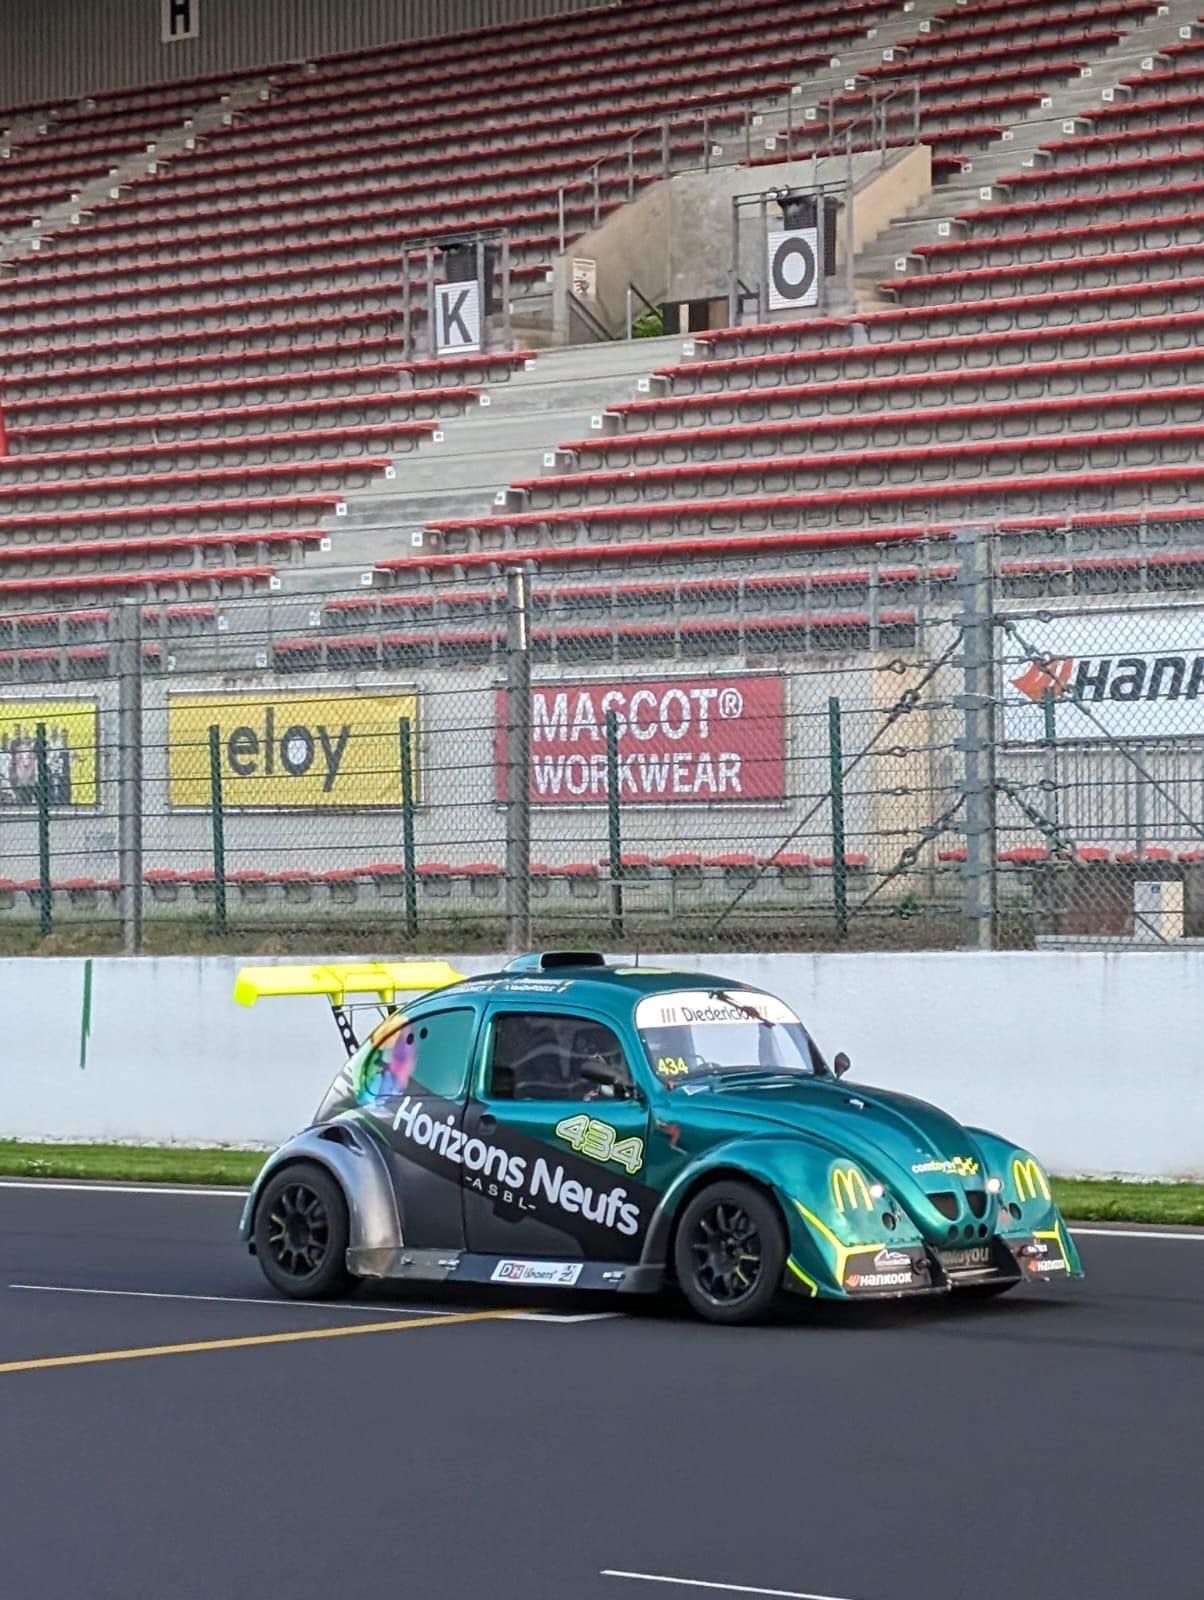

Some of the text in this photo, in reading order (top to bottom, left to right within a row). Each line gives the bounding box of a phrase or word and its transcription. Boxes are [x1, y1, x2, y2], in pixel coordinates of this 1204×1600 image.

[171, 0, 191, 35] H
[772, 237, 815, 299] O
[442, 289, 473, 345] K
[228, 706, 352, 793] eloy
[532, 752, 743, 795] WORKWEAR
[656, 1057, 689, 1075] 434
[392, 1095, 640, 1236] Horizons Neufs
[556, 1114, 644, 1174] 434
